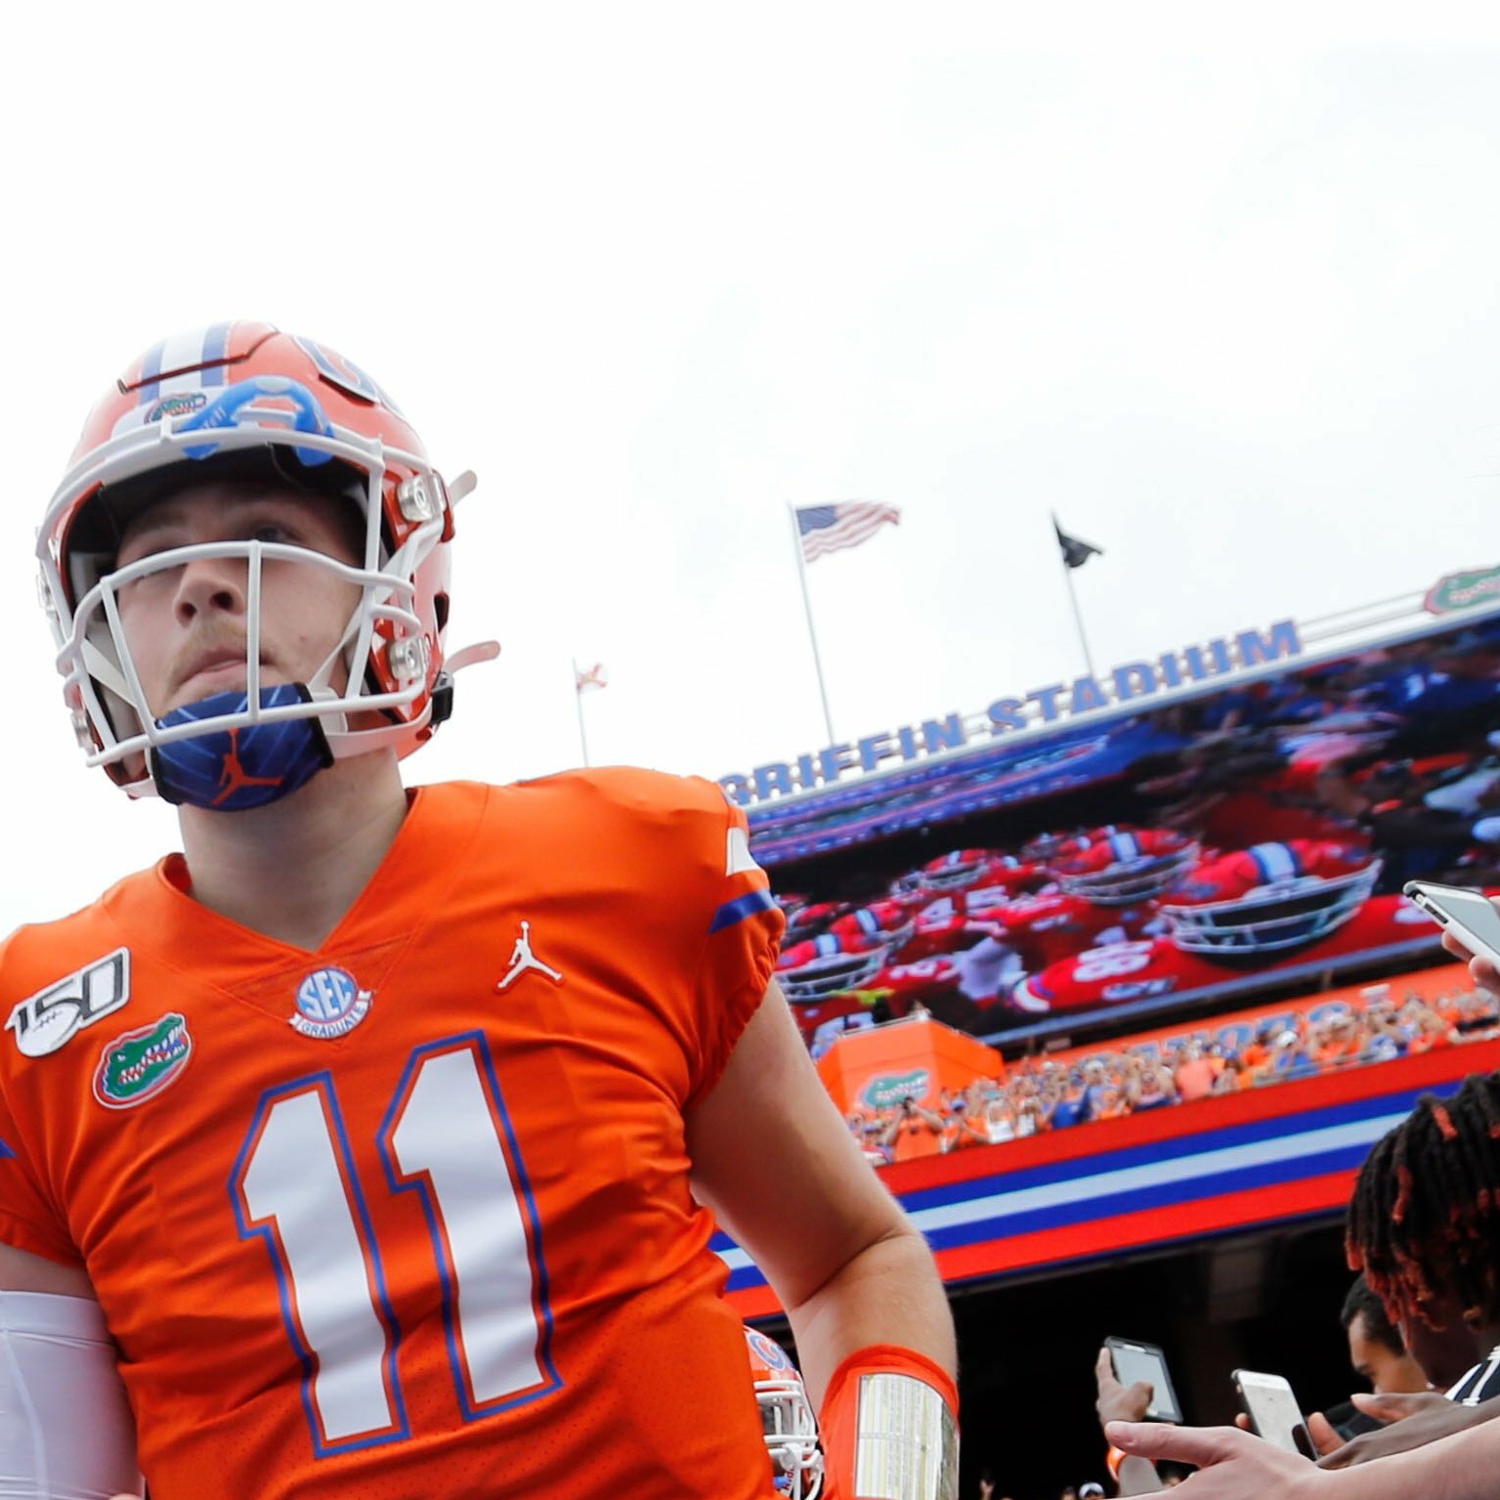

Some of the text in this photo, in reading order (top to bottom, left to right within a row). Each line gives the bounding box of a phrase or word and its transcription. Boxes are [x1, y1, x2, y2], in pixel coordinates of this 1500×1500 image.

[7, 948, 130, 1057] 150
[299, 968, 357, 1021] SEC
[300, 1004, 368, 1039] GRADUATE
[227, 1029, 564, 1459] 11
